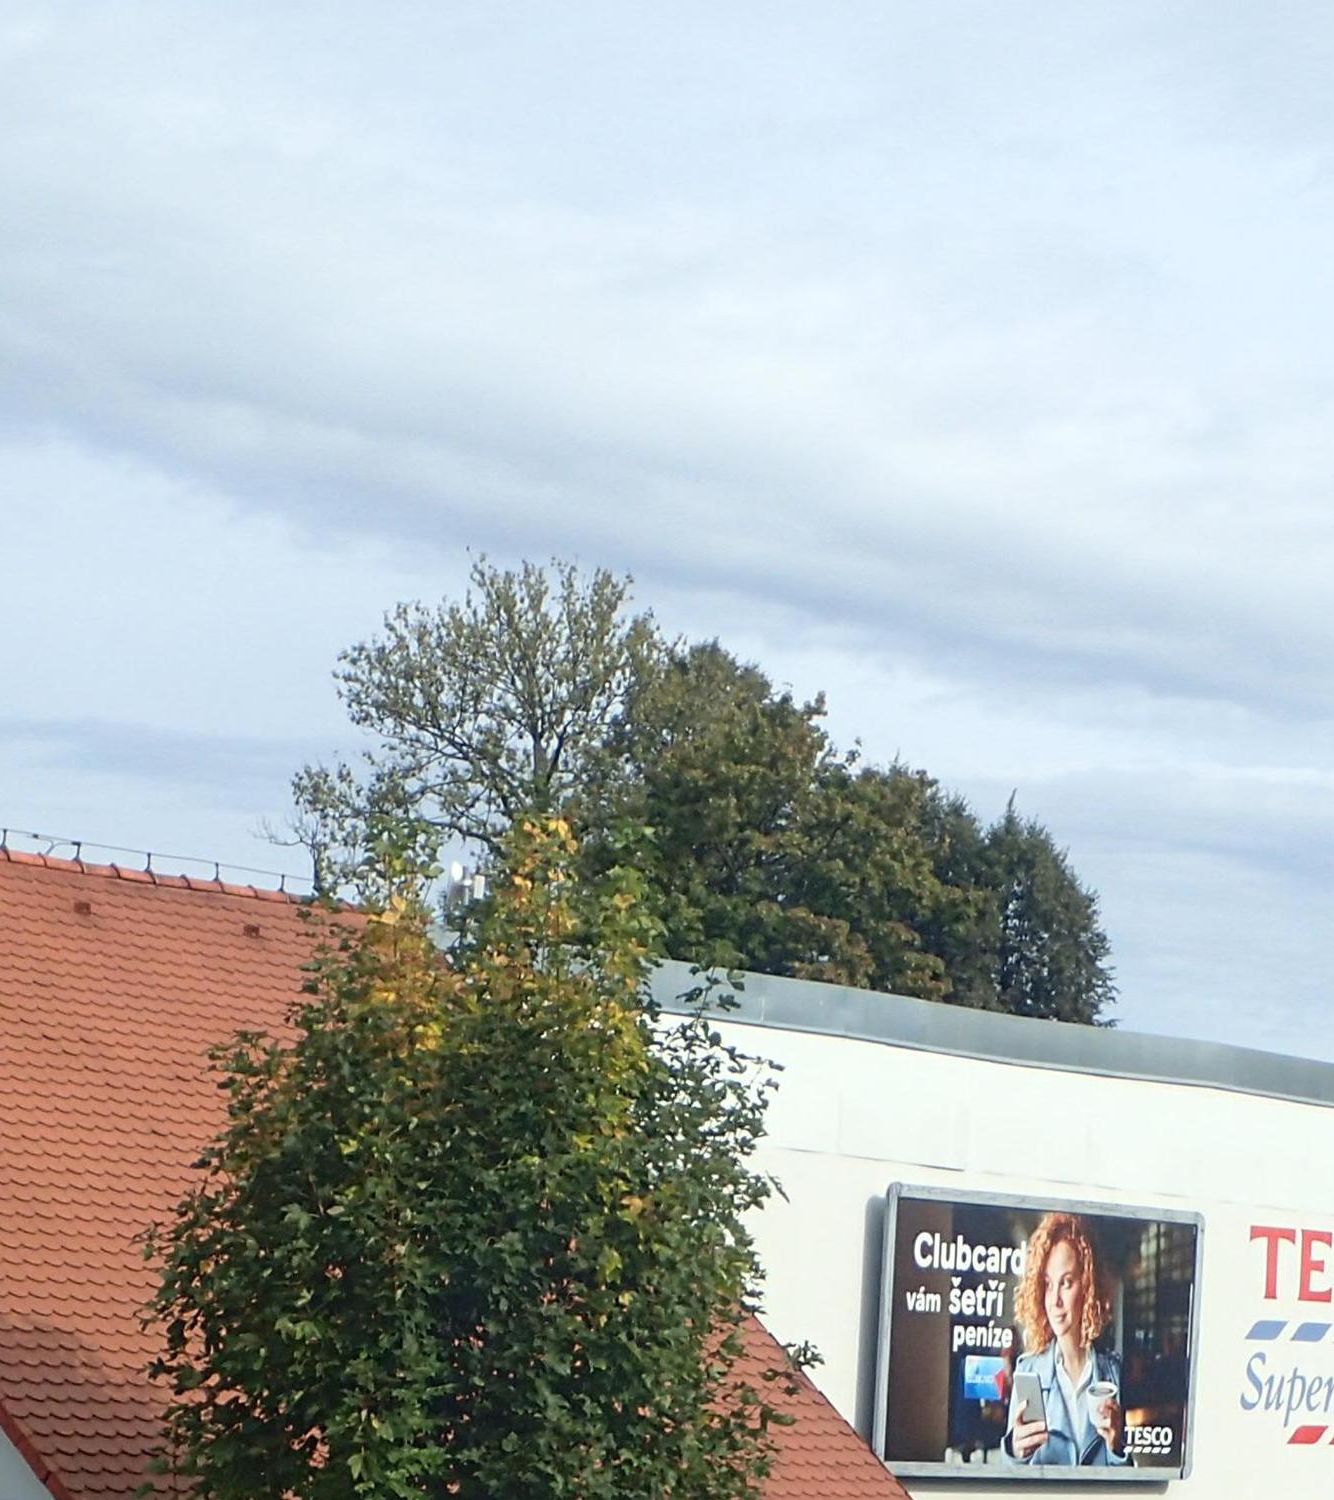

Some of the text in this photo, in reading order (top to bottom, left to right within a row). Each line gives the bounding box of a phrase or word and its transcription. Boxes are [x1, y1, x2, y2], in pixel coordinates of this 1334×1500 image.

[914, 1232, 1027, 1275] Clubcard
[906, 1277, 1006, 1317] vám šetří
[952, 1320, 1013, 1352] peníze
[1124, 1426, 1173, 1446] TESCO
